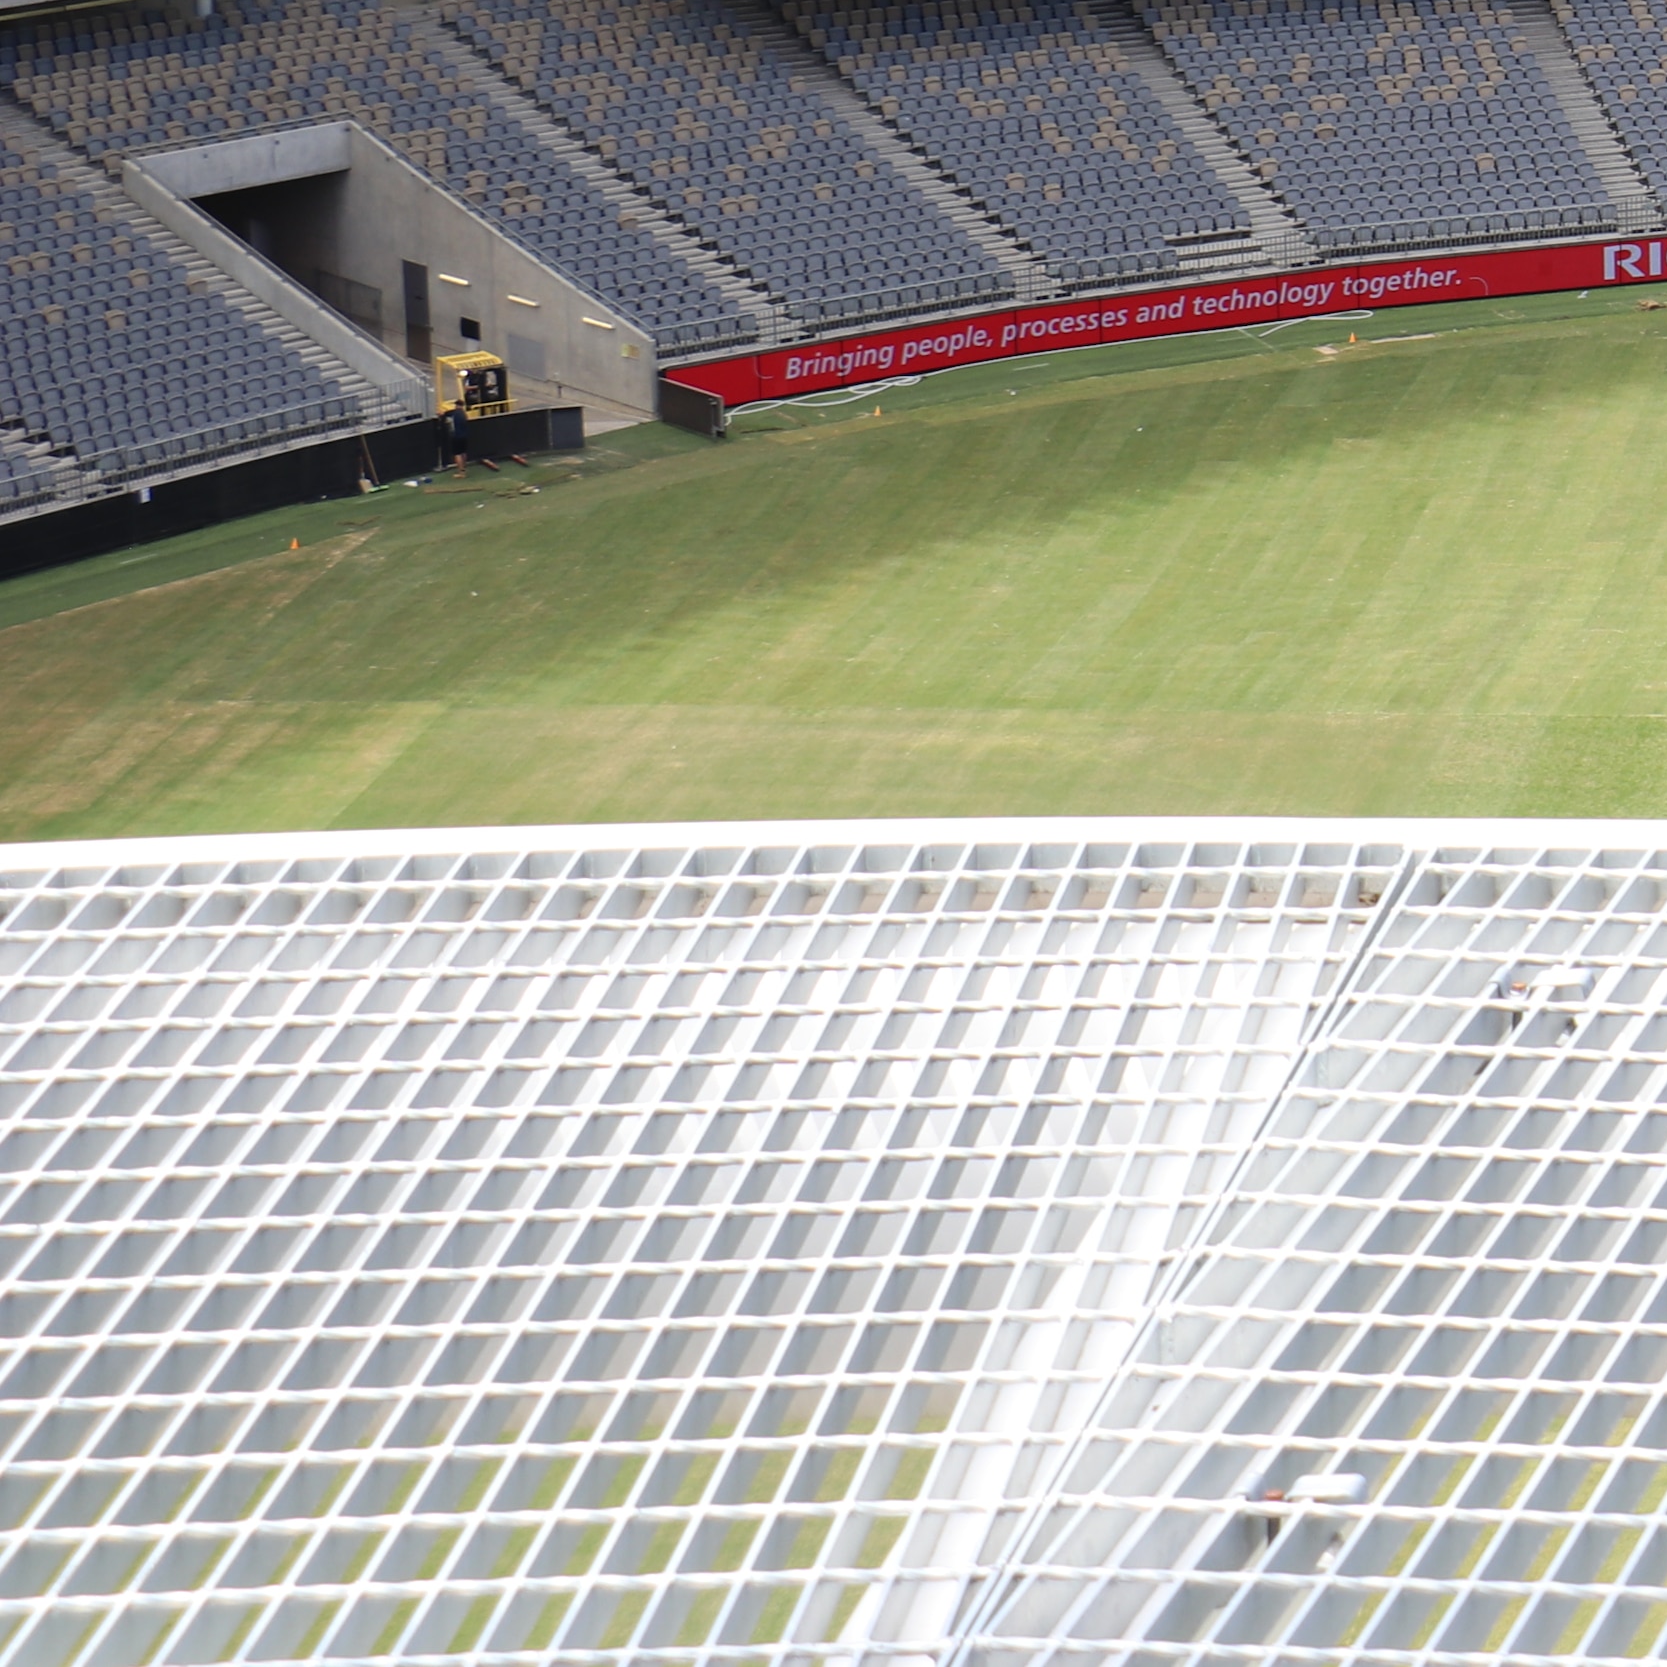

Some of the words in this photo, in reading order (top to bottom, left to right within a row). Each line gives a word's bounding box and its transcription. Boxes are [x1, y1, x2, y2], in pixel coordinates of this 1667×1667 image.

[786, 346, 894, 379] Bringing
[902, 327, 994, 363] people,
[1001, 310, 1126, 346] processes
[1136, 297, 1184, 322] and
[1194, 282, 1333, 315] technology
[1343, 268, 1461, 300] together.
